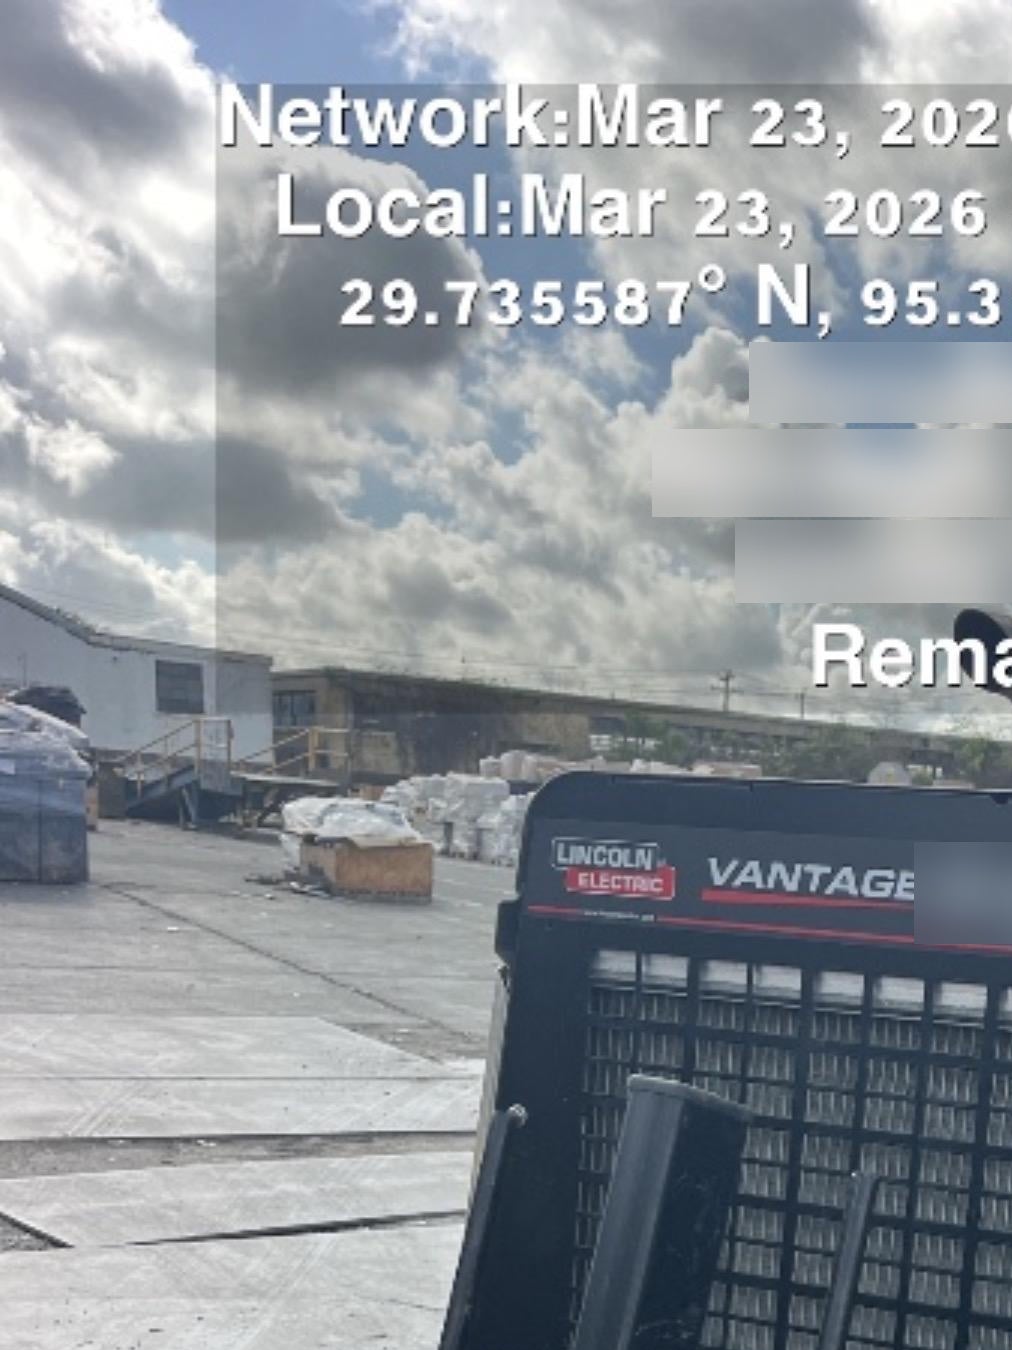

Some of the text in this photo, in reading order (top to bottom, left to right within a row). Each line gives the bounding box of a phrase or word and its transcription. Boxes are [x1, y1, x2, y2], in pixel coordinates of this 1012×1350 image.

[556, 841, 653, 872] LINCOLN
[577, 871, 665, 895] ELECTRIC
[707, 857, 915, 901] VANTAGE
